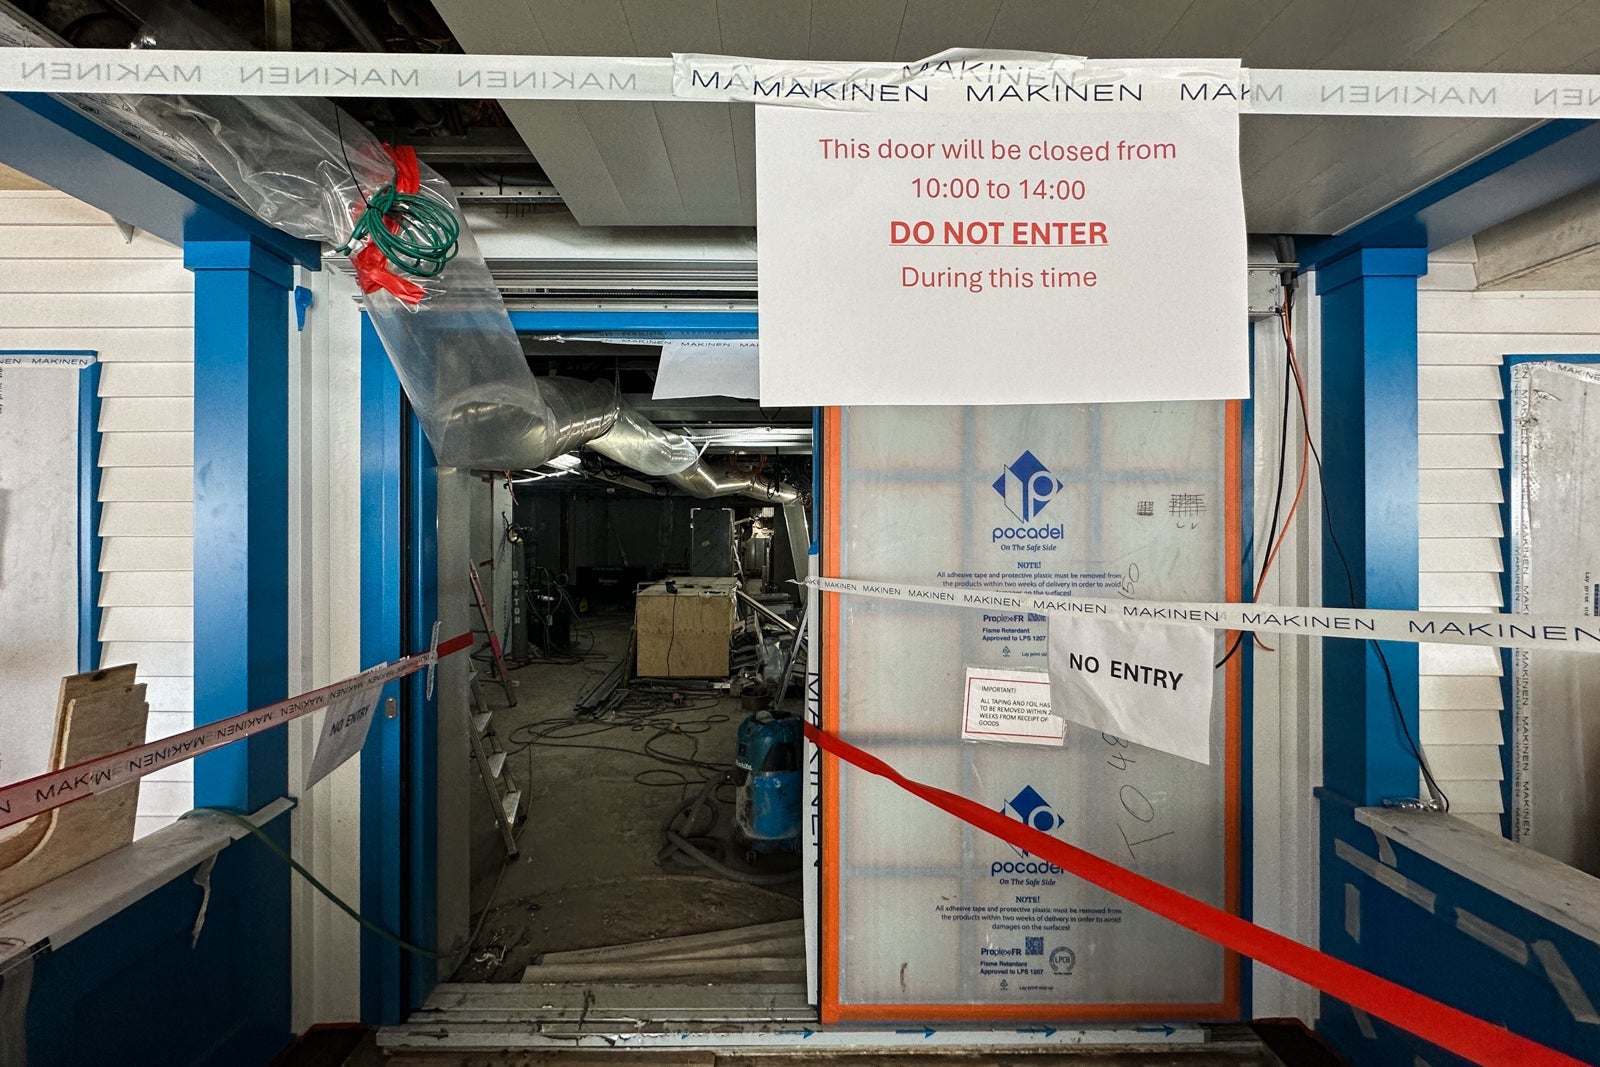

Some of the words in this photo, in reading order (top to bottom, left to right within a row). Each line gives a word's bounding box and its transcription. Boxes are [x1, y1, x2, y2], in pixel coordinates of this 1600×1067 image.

[753, 80, 928, 102] MAKINEN
[967, 84, 1142, 102] MAKINEN
[818, 138, 871, 159] This
[877, 140, 935, 159] door
[942, 139, 984, 160] will
[991, 139, 1021, 160] be
[1028, 140, 1110, 163] closed
[1117, 140, 1177, 160] from
[912, 177, 980, 199] 10:00
[986, 180, 1011, 200] to
[1019, 179, 1087, 201] 14:00
[889, 220, 935, 243] DO
[943, 220, 1005, 243] NOT
[1012, 221, 1109, 244] ENTER
[901, 265, 984, 294] During
[988, 267, 1035, 288] this
[1040, 270, 1098, 288] time
[992, 524, 1064, 542] pocadel
[1017, 561, 1041, 569] NOTE!
[824, 581, 856, 591] MAKINEN
[862, 585, 900, 596] MAKINEN
[908, 589, 955, 601] MAKINEN
[963, 594, 1021, 607] MAKINEN
[1033, 600, 1107, 614] MAKINEN
[1123, 606, 1220, 622] MAKINEN
[1242, 612, 1375, 631] MAKINEN
[1409, 620, 1600, 643] MAKINEN
[1070, 653, 1099, 673] NO
[1110, 660, 1184, 691] ENTRY
[1521, 651, 1529, 706] MAKINEN
[981, 685, 1016, 693] IMPORTANT!
[280, 695, 324, 716] MAKINEN
[991, 698, 1011, 706] TAPING
[216, 711, 273, 739] MAKINEN
[329, 721, 343, 737] NO
[345, 703, 371, 728] ENTRY
[129, 734, 206, 772] MAKINEN
[1521, 716, 1529, 771] MAKINEN
[1522, 781, 1530, 836] MAKINEN
[1025, 879, 1041, 887] Safe
[992, 923, 1021, 931] damages
